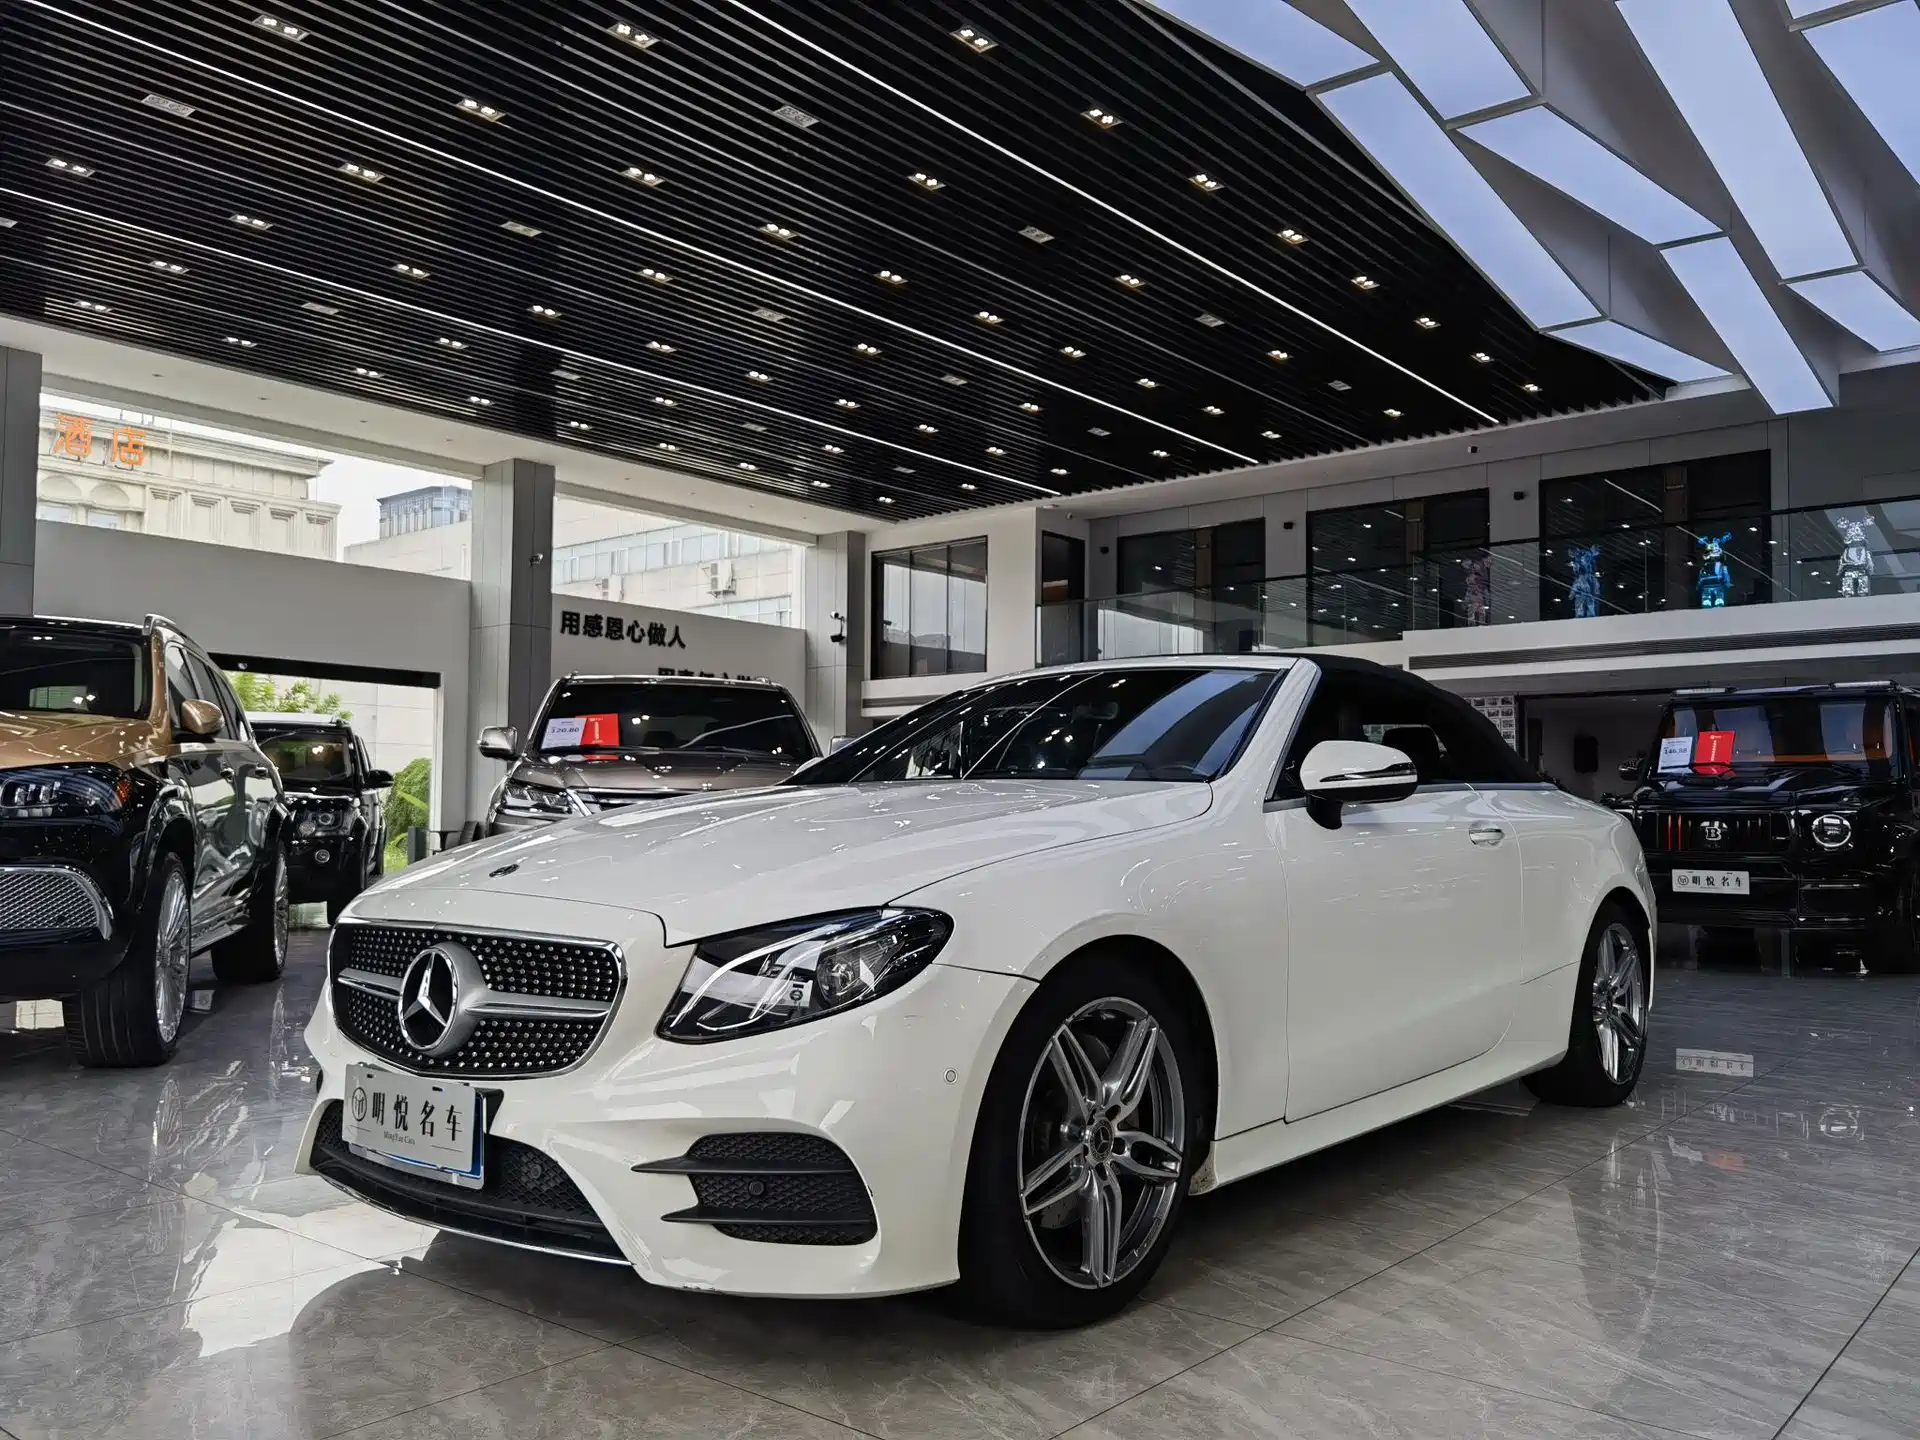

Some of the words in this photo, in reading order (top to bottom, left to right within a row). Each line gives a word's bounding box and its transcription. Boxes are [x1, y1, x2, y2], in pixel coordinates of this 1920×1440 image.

[51, 412, 147, 465] 酒店
[561, 610, 687, 649] 用感恩心做人
[371, 1091, 463, 1141] 明悦名车
